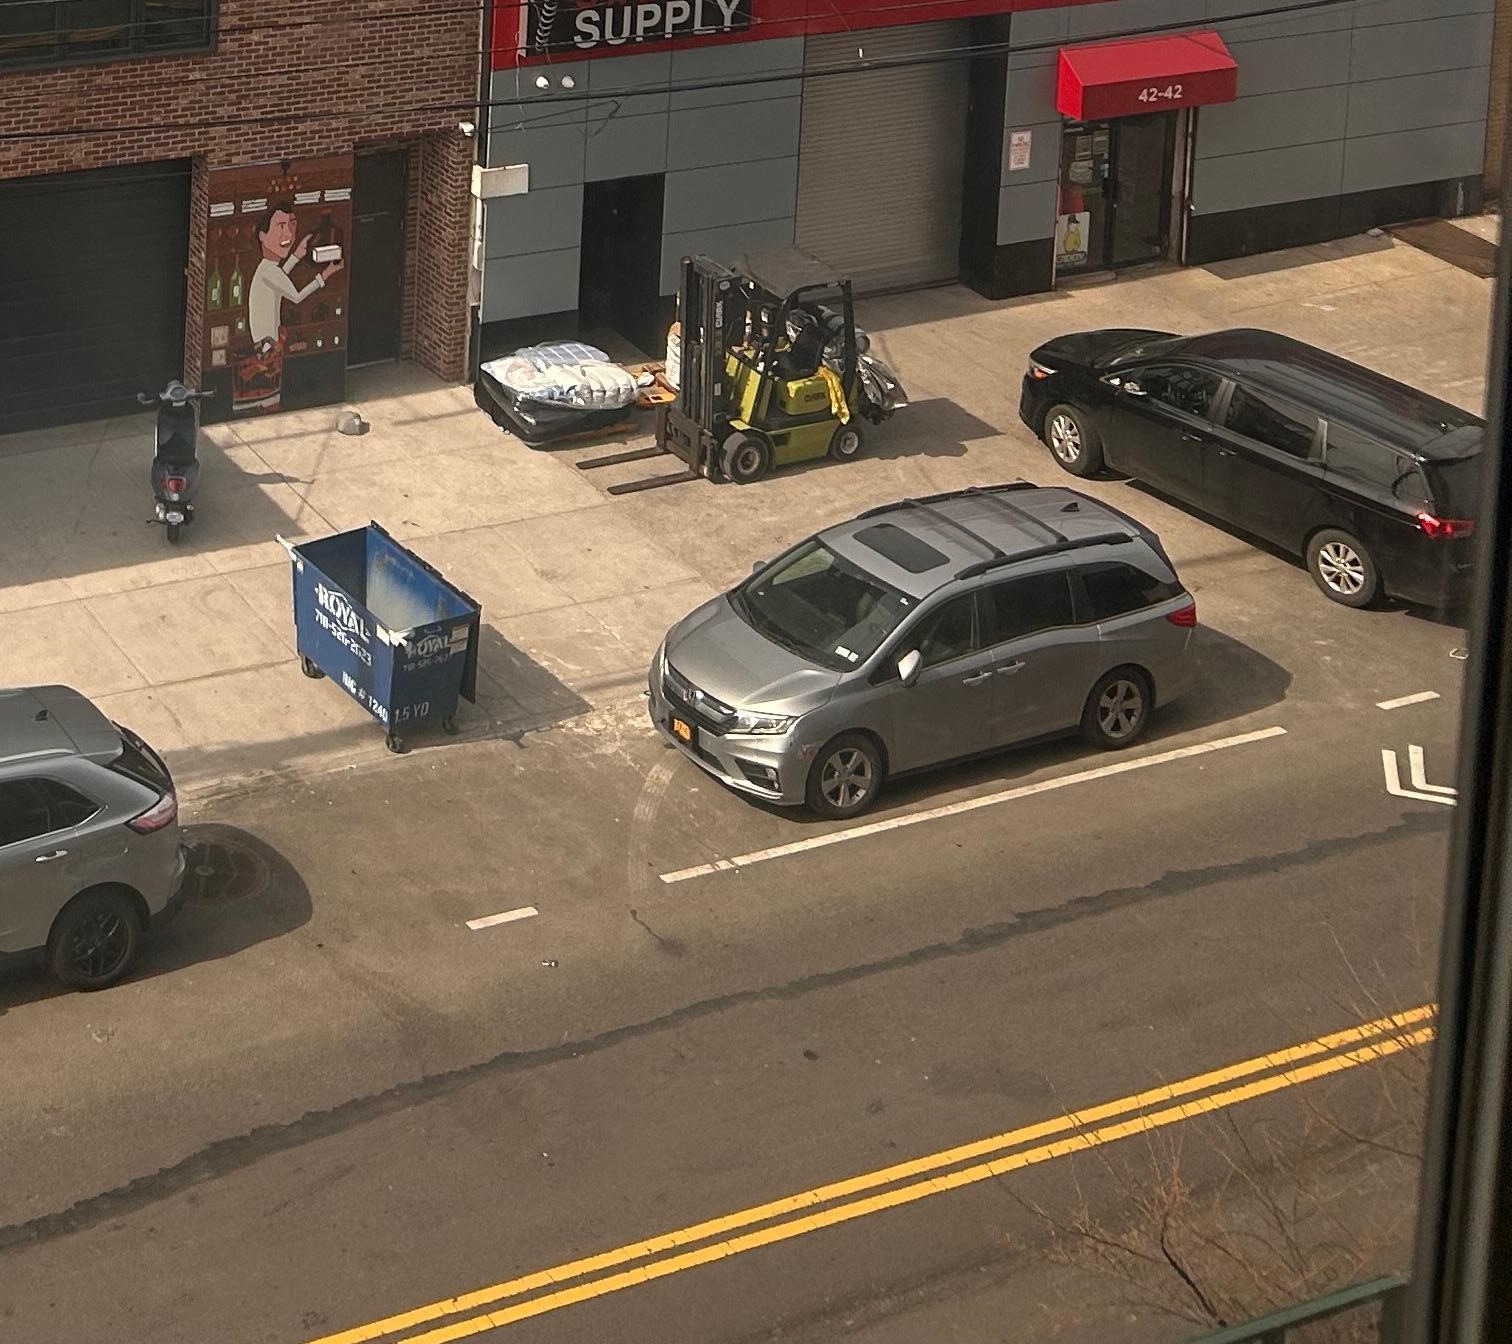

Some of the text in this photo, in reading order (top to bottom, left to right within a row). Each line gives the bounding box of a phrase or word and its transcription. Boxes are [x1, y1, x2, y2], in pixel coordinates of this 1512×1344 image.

[1138, 84, 1183, 102] 42-42
[317, 582, 370, 644] ROYAL
[413, 701, 430, 718] YD
